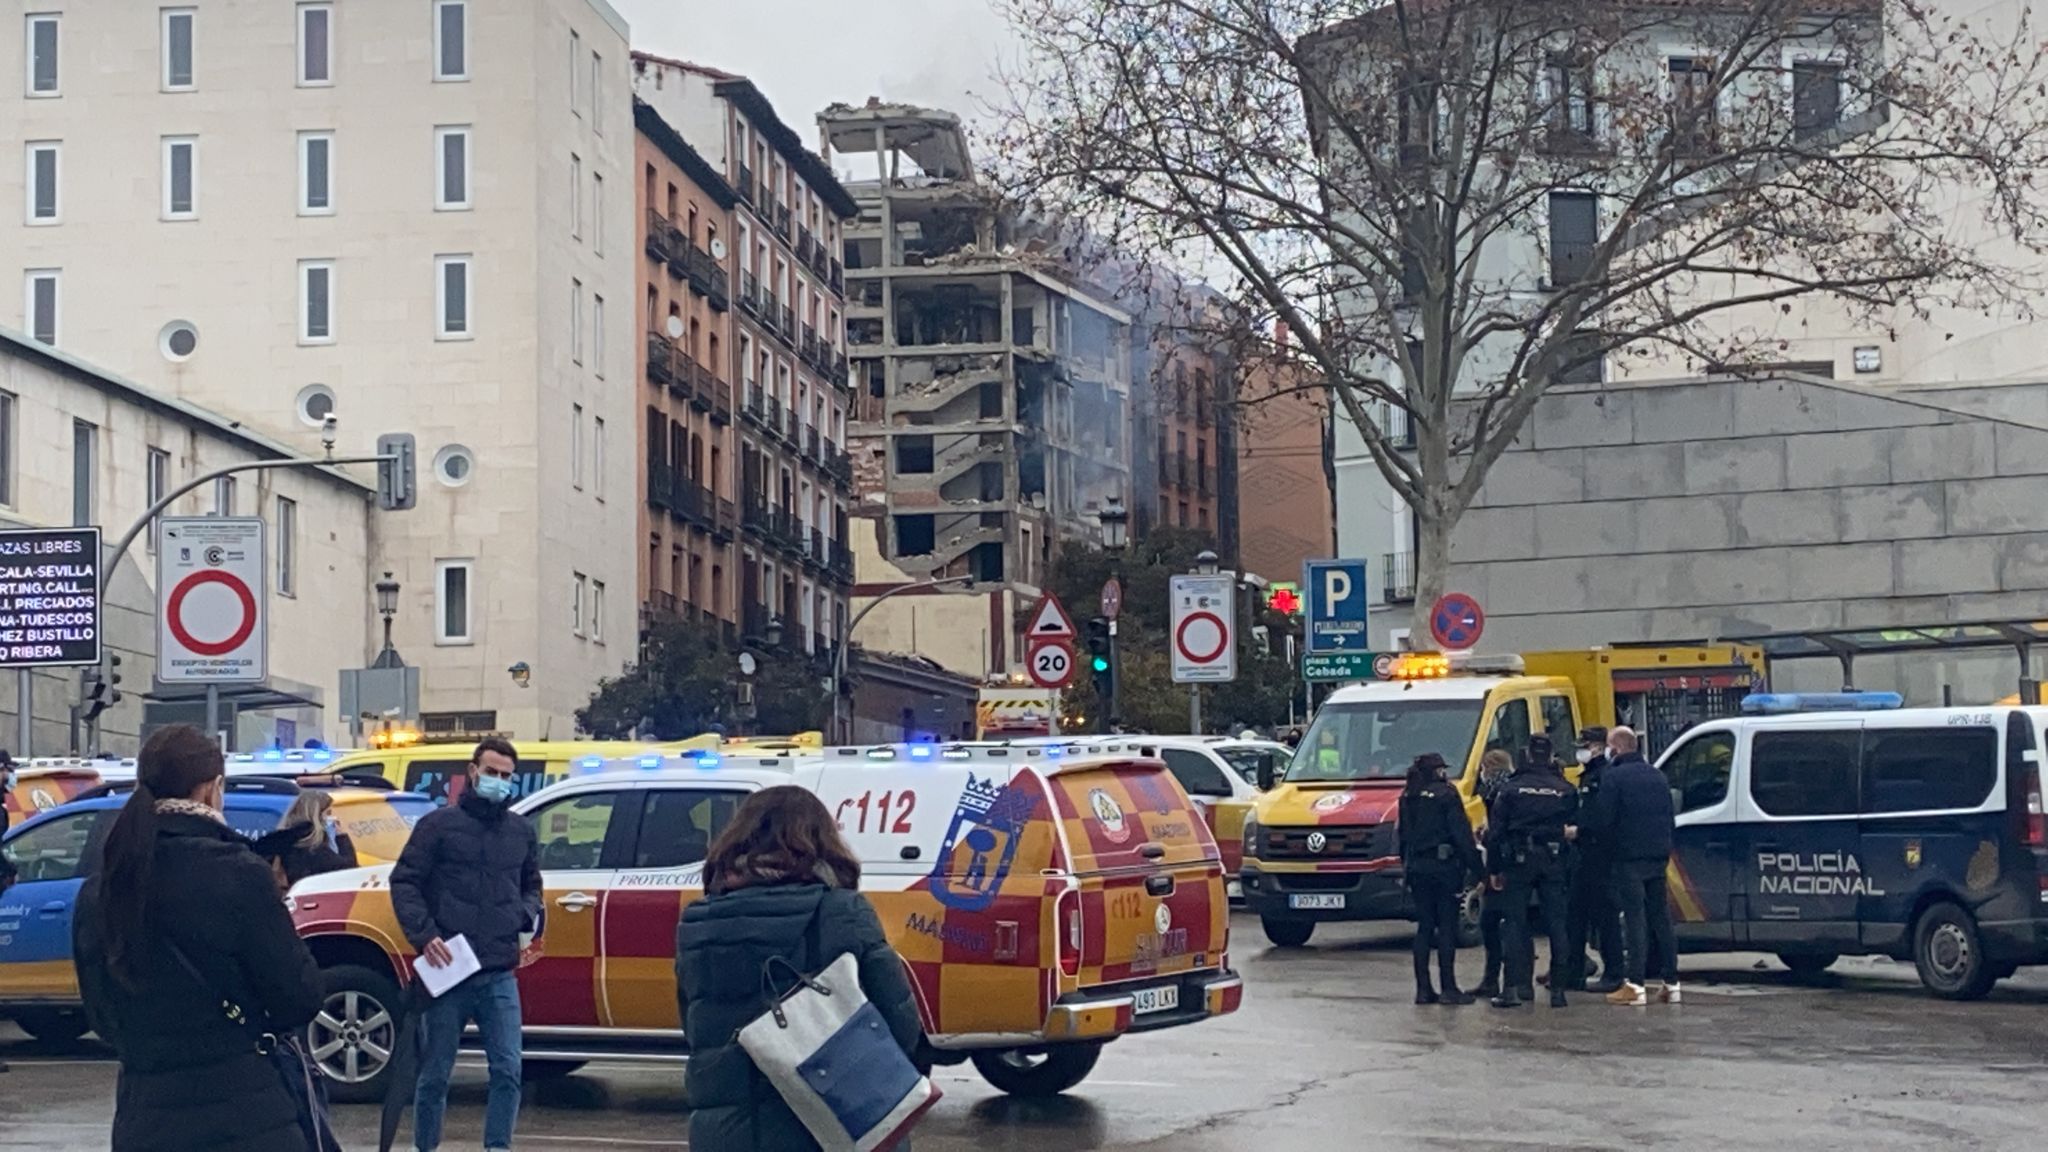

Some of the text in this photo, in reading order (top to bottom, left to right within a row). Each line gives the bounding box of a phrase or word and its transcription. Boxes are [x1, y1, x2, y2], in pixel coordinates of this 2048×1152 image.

[34, 540, 82, 553] LIBRES
[1326, 570, 1351, 617] P
[15, 596, 94, 610] PRECIADOS
[27, 628, 94, 641] BUSTILLO
[11, 645, 62, 658] RIBERA
[1038, 655, 1065, 671] 20
[1306, 666, 1351, 677] Cebada
[1758, 849, 1860, 872] POLICÍA
[1760, 876, 1885, 895] NACIONAL
